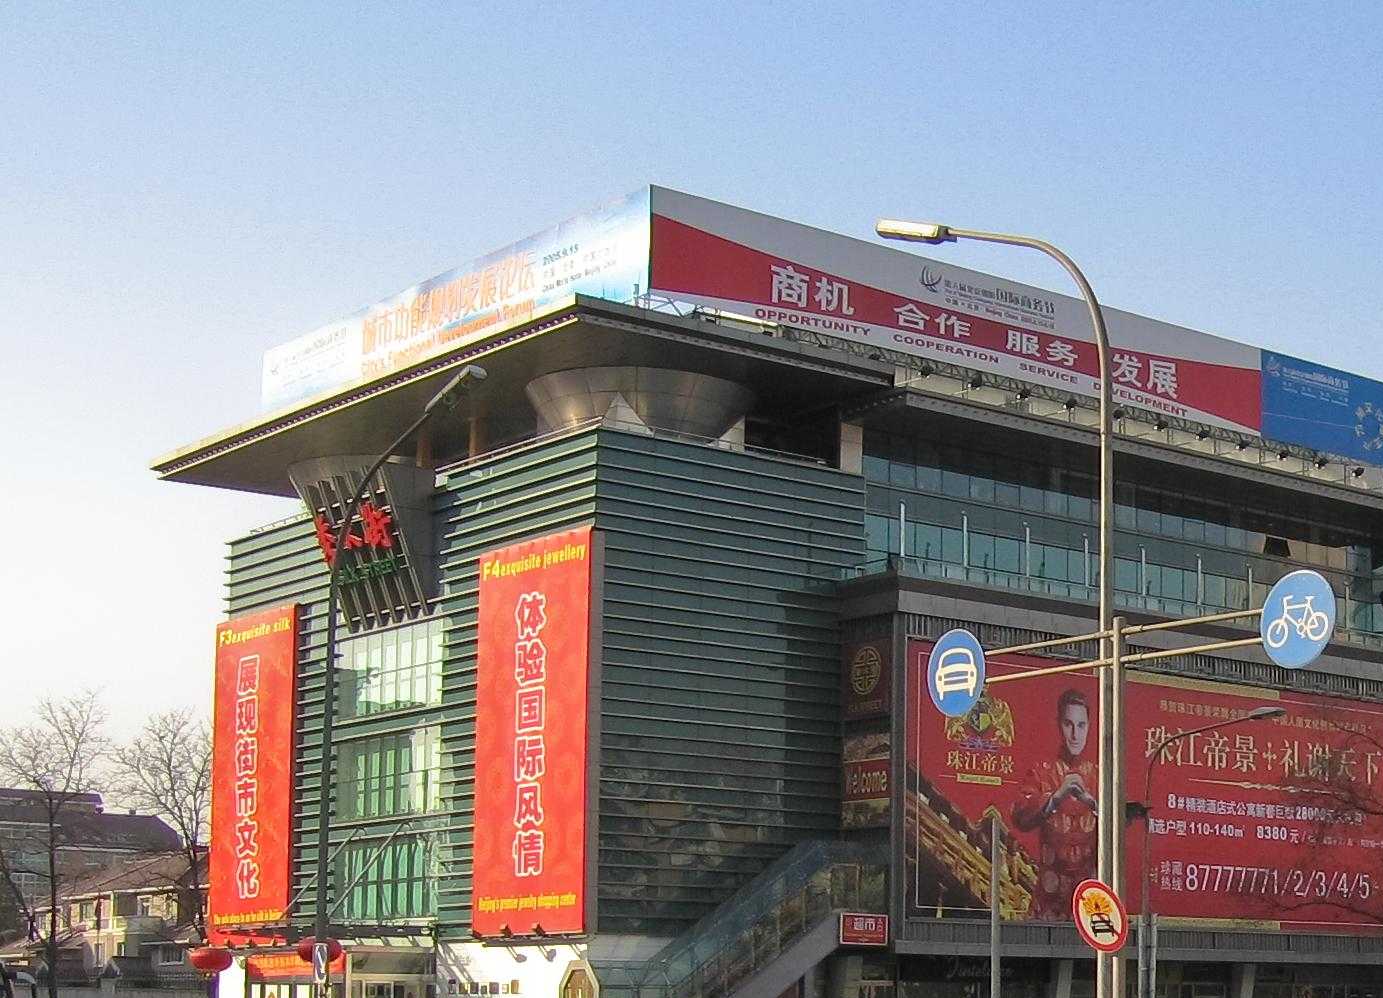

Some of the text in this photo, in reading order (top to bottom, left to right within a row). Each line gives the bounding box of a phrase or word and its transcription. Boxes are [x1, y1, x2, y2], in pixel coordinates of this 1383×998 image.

[770, 264, 854, 316] 商机
[893, 303, 972, 338] 合作
[1006, 329, 1078, 366] 服务
[1112, 353, 1179, 399] 发展
[755, 308, 1187, 417] OPPORTUNITY COOPERATION SERVICE DVELOPMENT
[543, 544, 586, 568] jewellery
[272, 617, 291, 633] silk
[513, 591, 547, 877] 体验国际风情
[946, 750, 1014, 774] 珠江帝景
[1145, 725, 1381, 785] 珠江帝景 礼谢天下
[236, 654, 260, 898] 展现街市文化
[1185, 864, 1371, 898] 87777771/2/3/4/5
